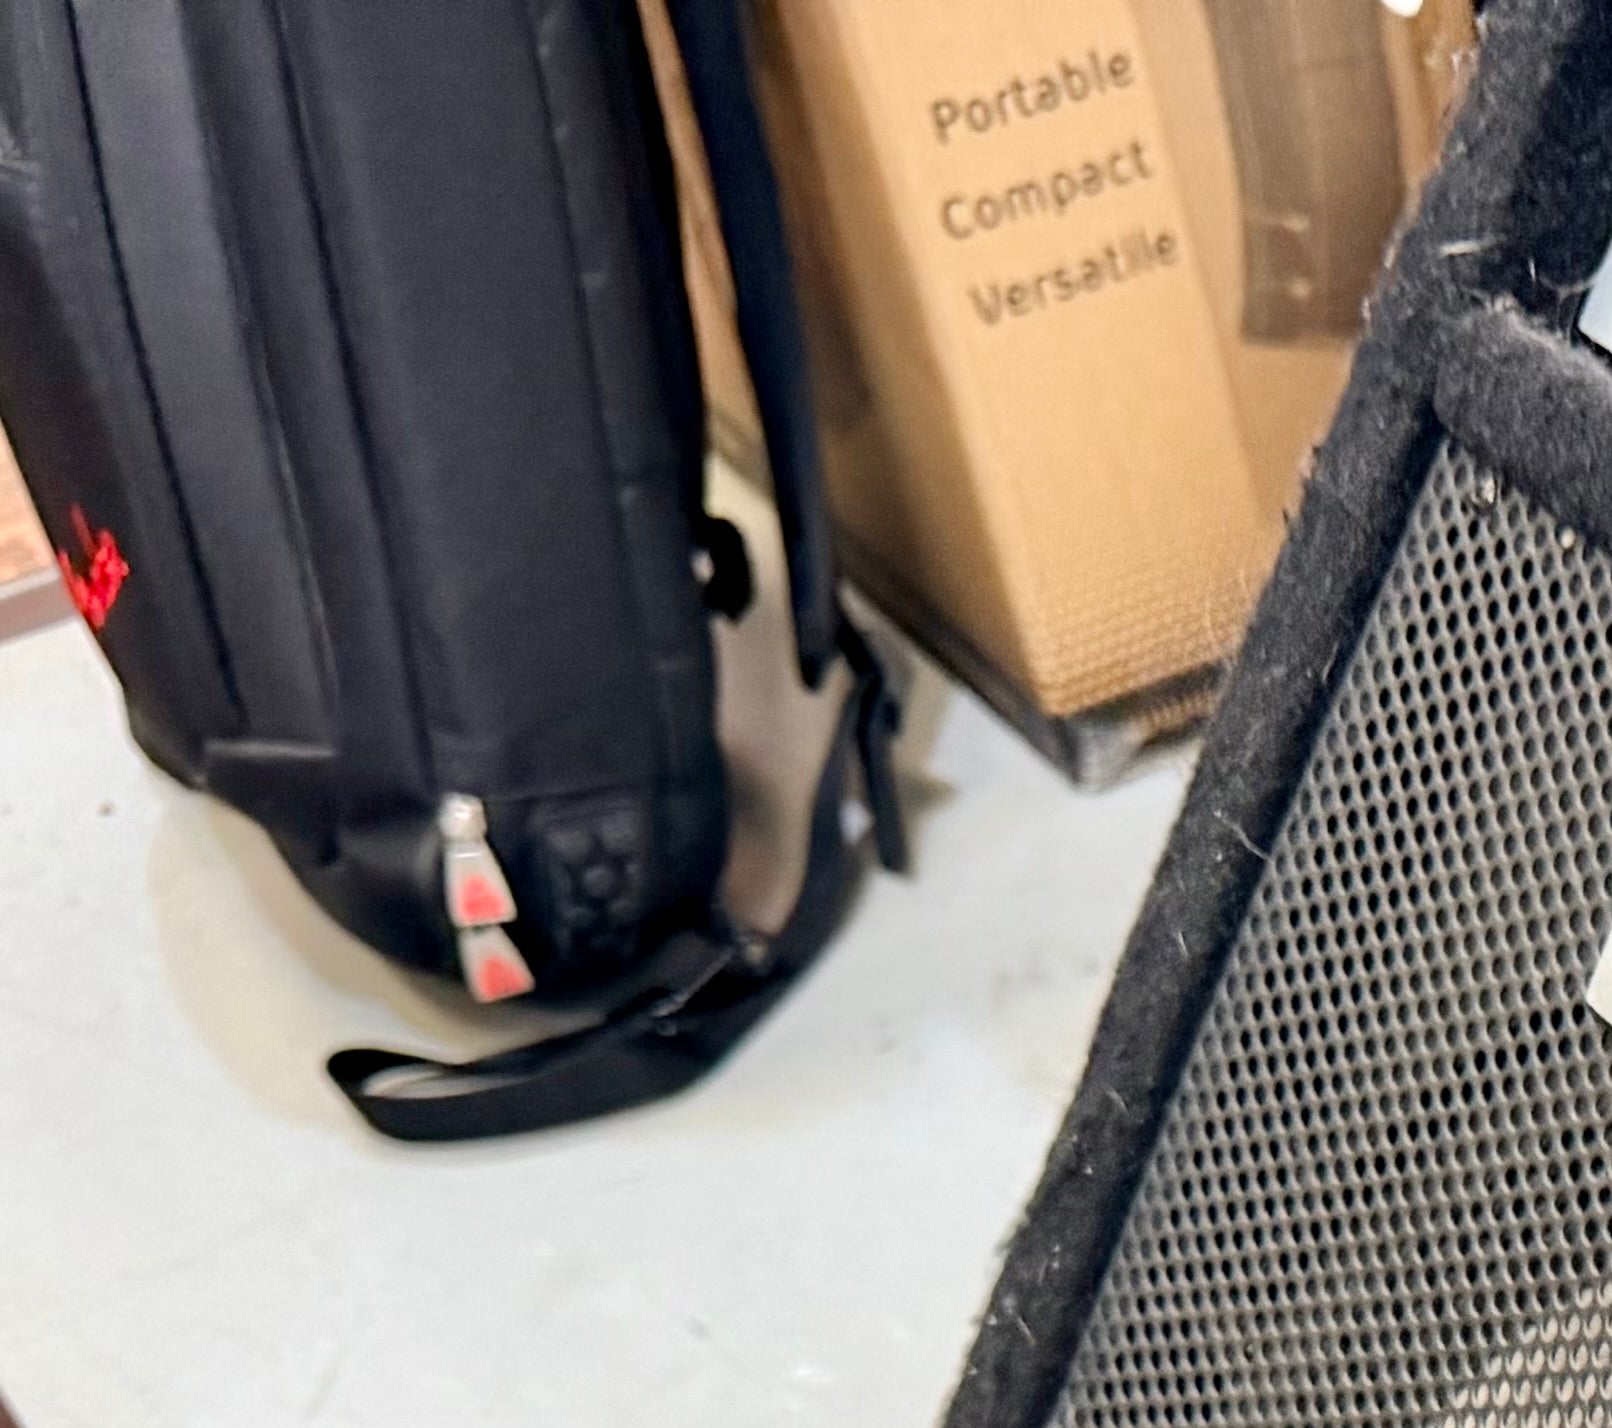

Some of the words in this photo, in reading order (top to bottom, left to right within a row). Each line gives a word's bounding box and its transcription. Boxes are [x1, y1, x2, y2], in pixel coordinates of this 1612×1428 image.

[929, 45, 1134, 145] Portable
[939, 138, 1151, 241] Compact
[966, 227, 1178, 327] Versatile
